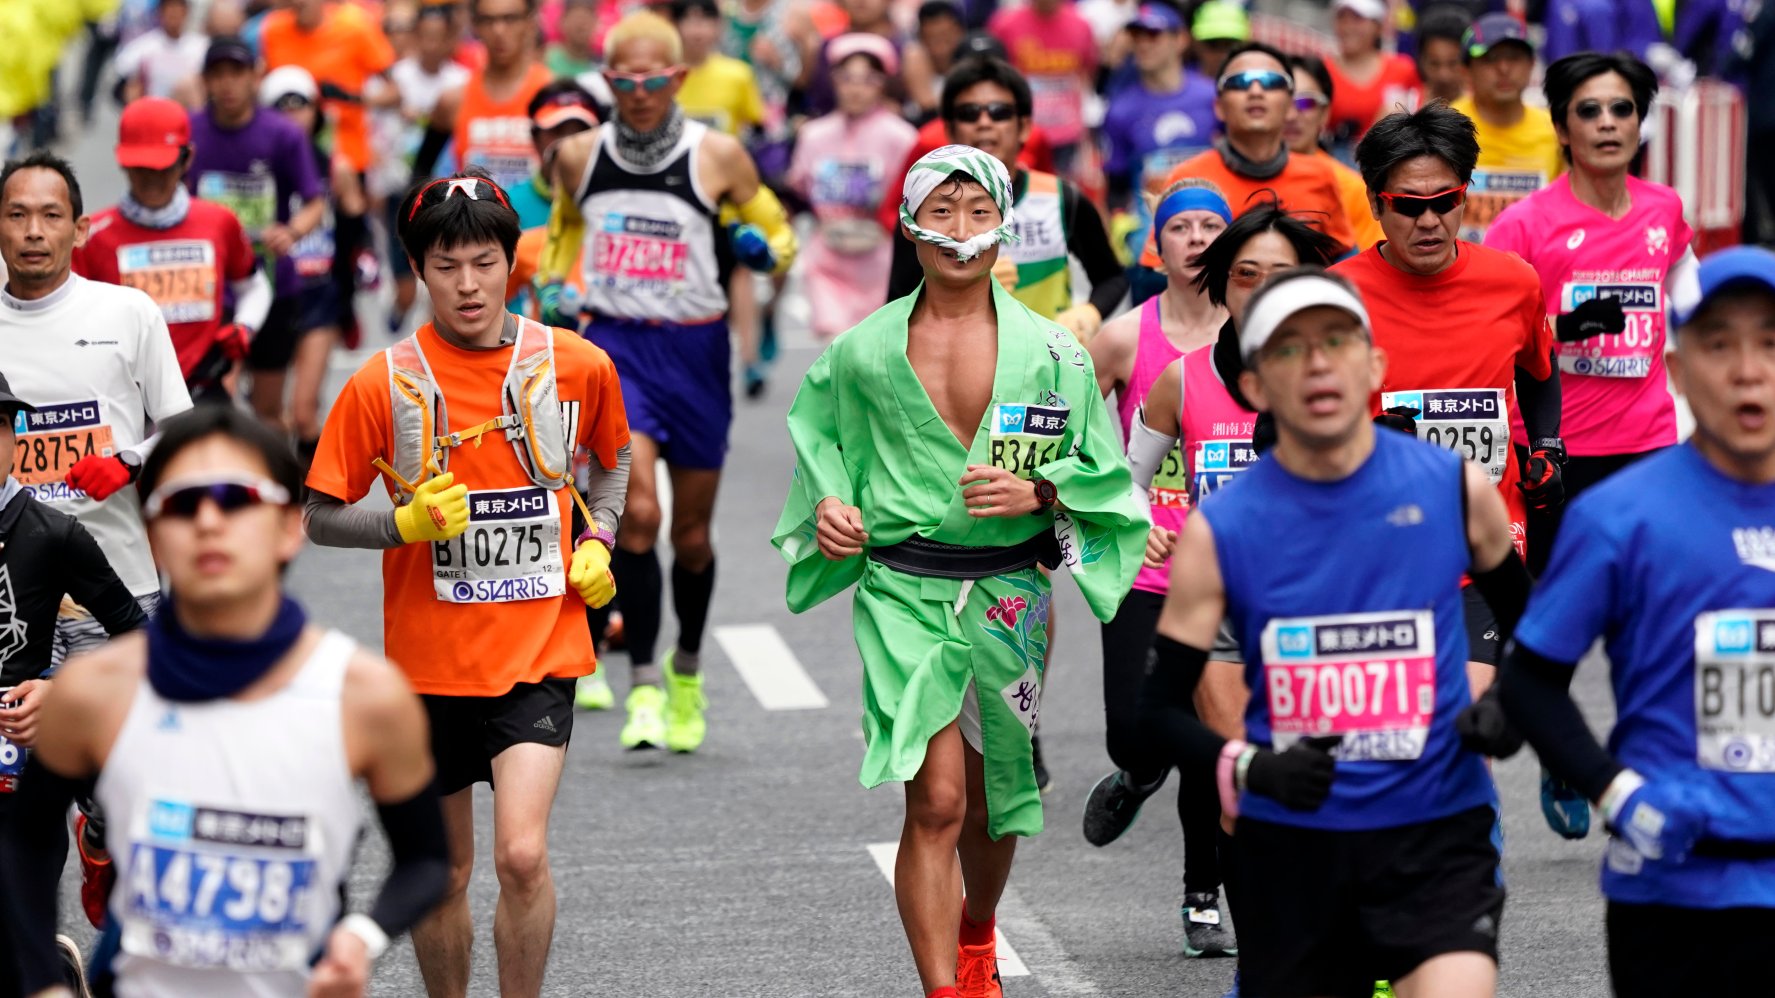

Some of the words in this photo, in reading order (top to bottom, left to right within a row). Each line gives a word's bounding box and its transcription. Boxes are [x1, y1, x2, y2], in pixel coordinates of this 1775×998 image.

[30, 406, 95, 426] 東京メトロ
[1428, 398, 1495, 414] 東京メトロ
[1212, 422, 1256, 436] 湘南美
[11, 432, 96, 474] 28754
[992, 439, 1061, 477] B346
[475, 496, 544, 515] 東京メトロ
[434, 523, 543, 568] B10275
[437, 571, 460, 579] GATE
[542, 564, 552, 573] 12
[476, 576, 549, 601] STARTS
[1269, 661, 1409, 719] B70071
[130, 845, 294, 923] A4798
